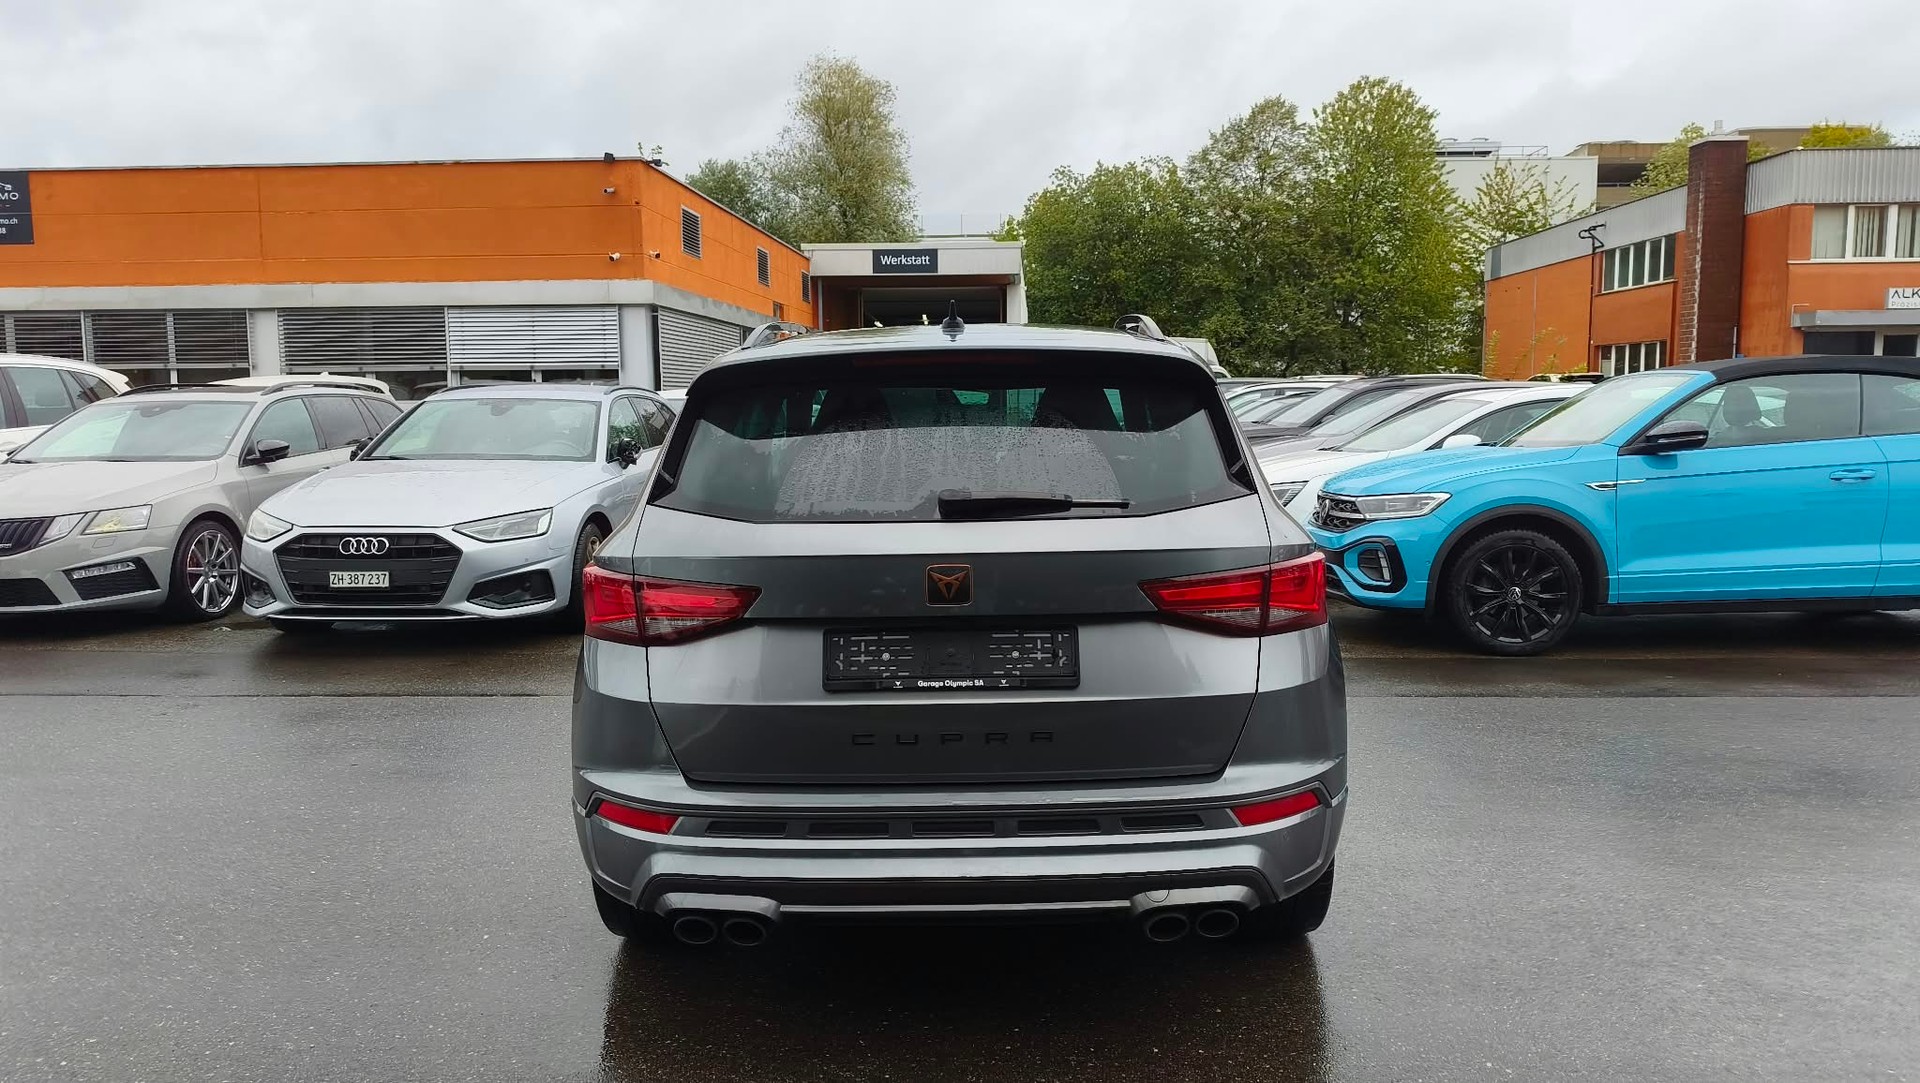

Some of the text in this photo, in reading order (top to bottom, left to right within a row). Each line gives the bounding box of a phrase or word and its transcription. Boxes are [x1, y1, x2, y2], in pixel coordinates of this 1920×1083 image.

[880, 254, 930, 265] Werkstatt
[917, 680, 944, 688] Garage
[944, 679, 974, 688] Olympic
[852, 731, 1054, 745] CUPRA
